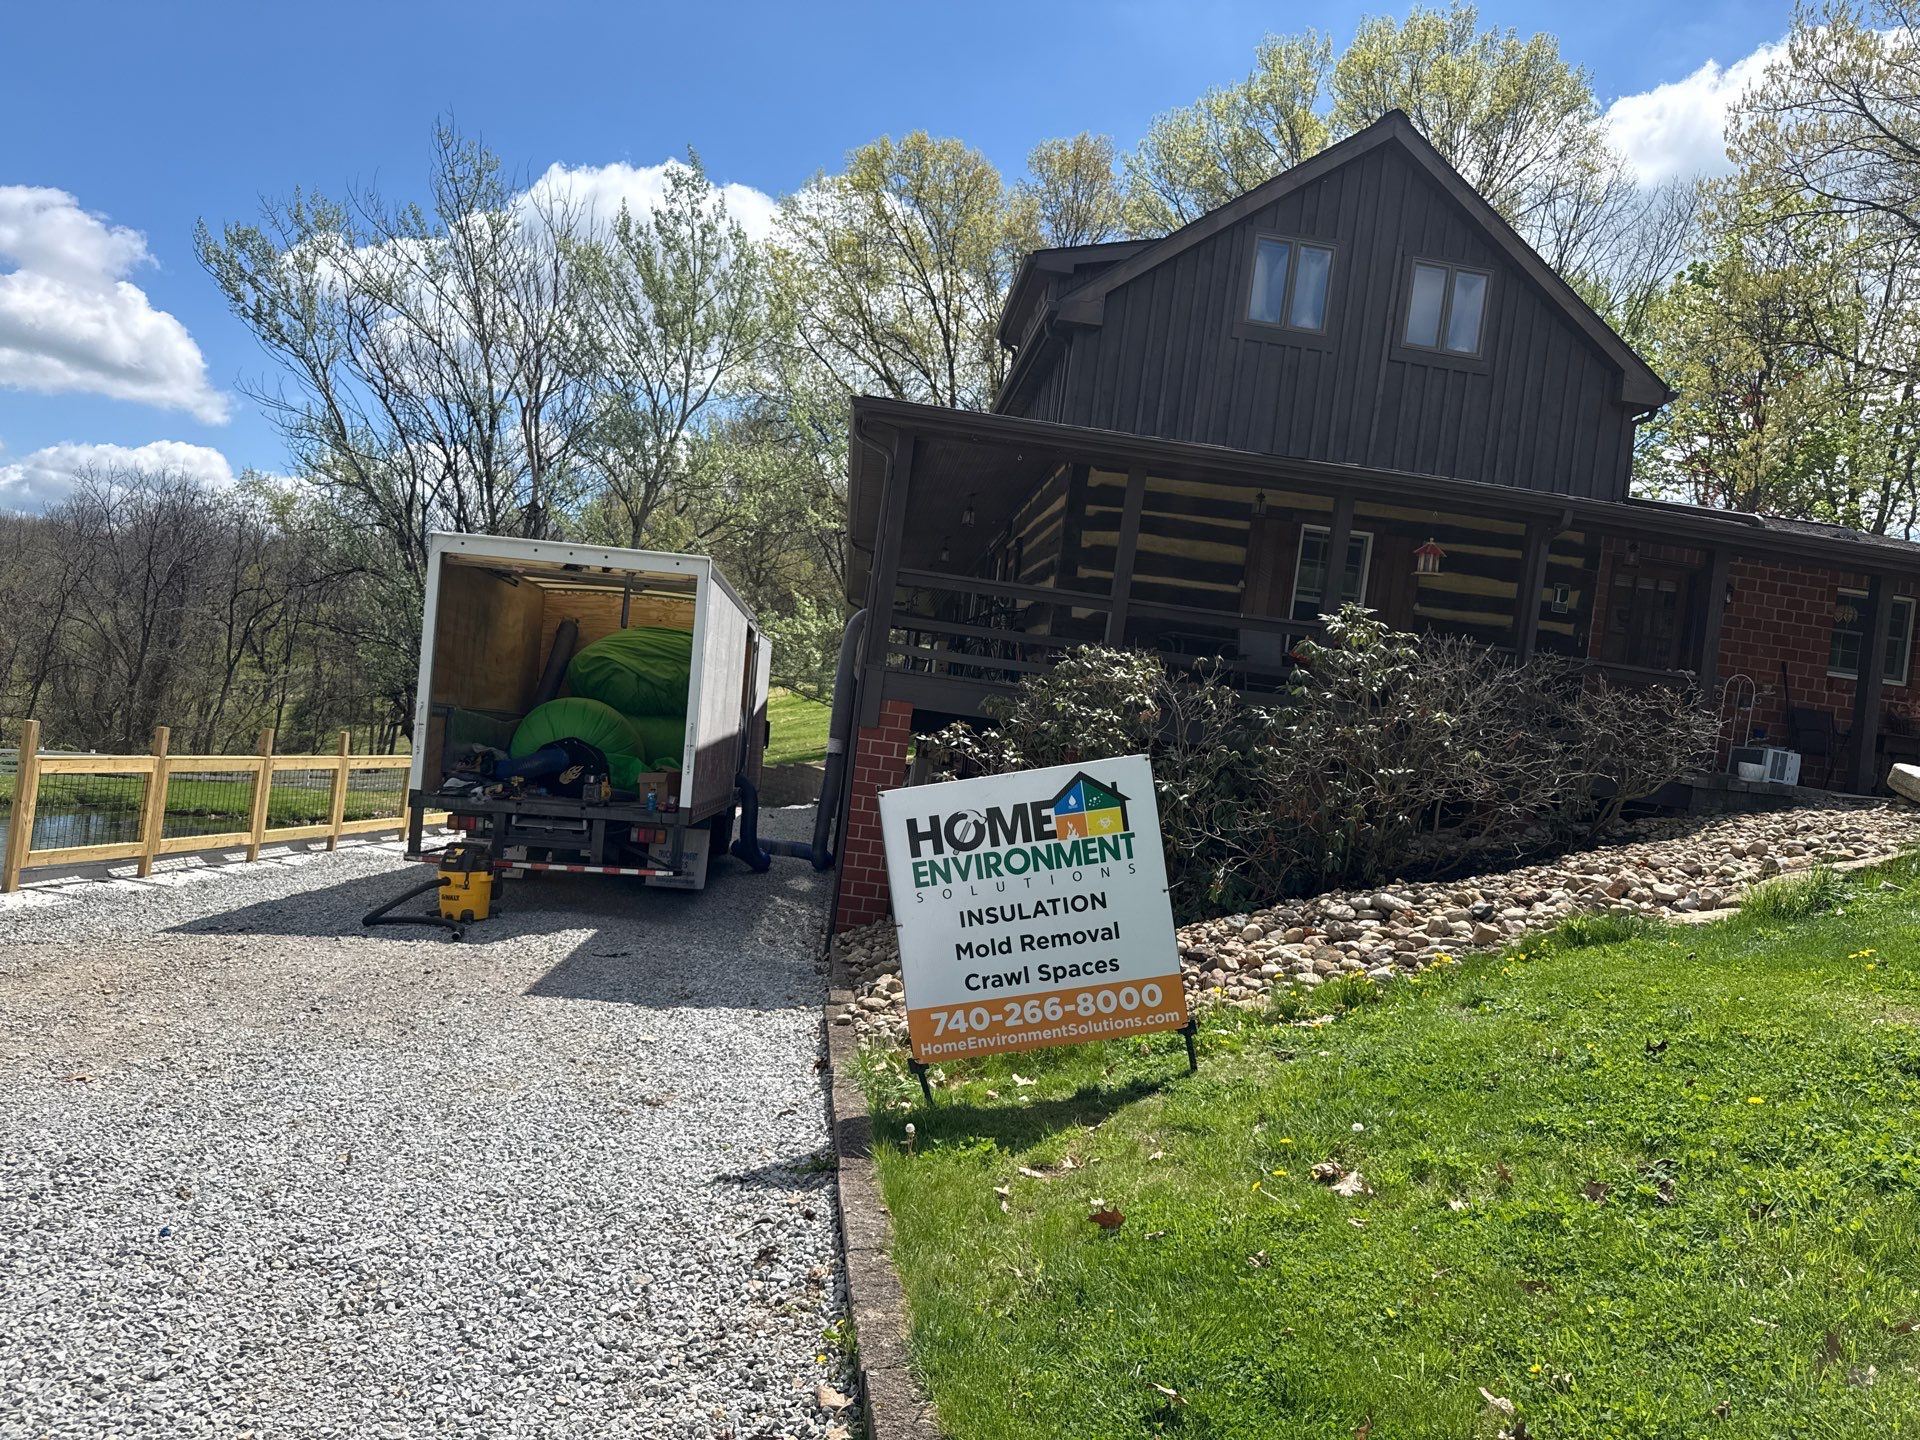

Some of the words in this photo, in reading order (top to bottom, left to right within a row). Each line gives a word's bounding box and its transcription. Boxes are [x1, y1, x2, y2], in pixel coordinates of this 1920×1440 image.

[906, 800, 1056, 858] HOME
[912, 833, 1135, 888] ENVIRONMENT
[916, 863, 1136, 903] SOLUTIONS
[959, 891, 1107, 928] INSULATION
[955, 936, 1013, 960] Mold
[1020, 921, 1120, 951] Removal
[964, 965, 1030, 991] Crawl
[1037, 958, 1120, 984] Spaces
[931, 984, 1163, 1037] 740-266-8000
[921, 1010, 1180, 1056] HomeEnvironmentSolutions.com
